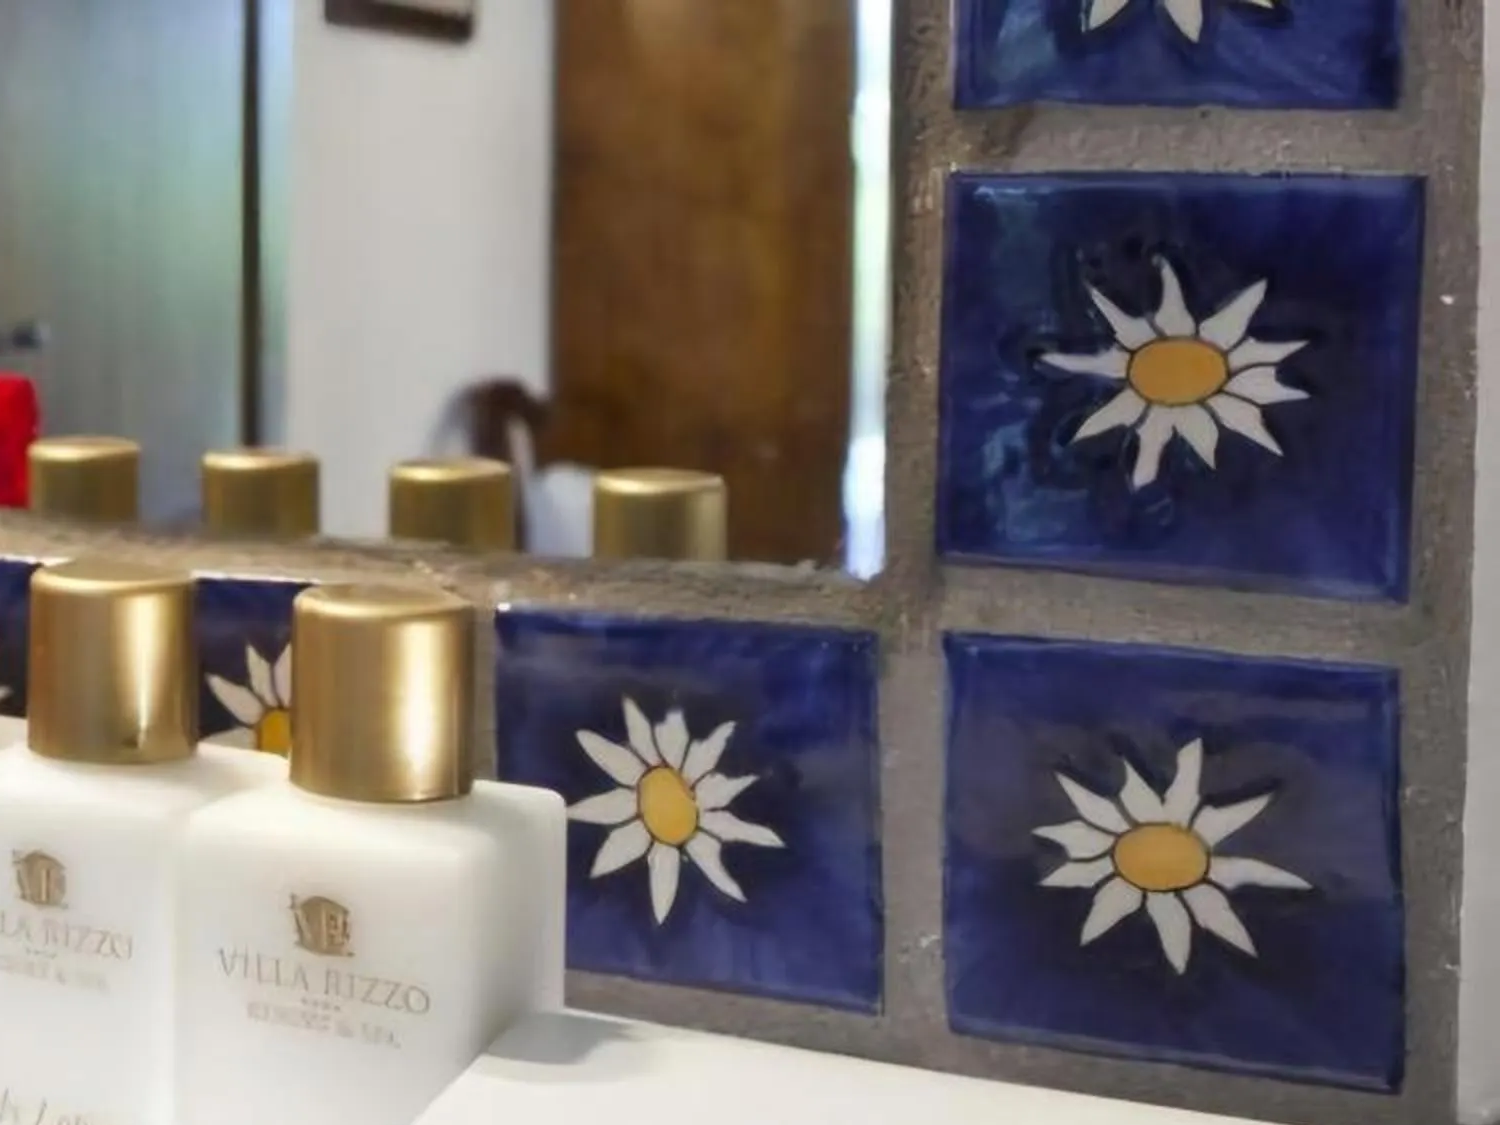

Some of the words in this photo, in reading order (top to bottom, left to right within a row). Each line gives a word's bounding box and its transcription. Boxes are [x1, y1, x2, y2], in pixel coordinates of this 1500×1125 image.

[42, 918, 134, 961] RIZZO
[216, 946, 310, 992] VILLA
[323, 967, 432, 1016] RIZZO
